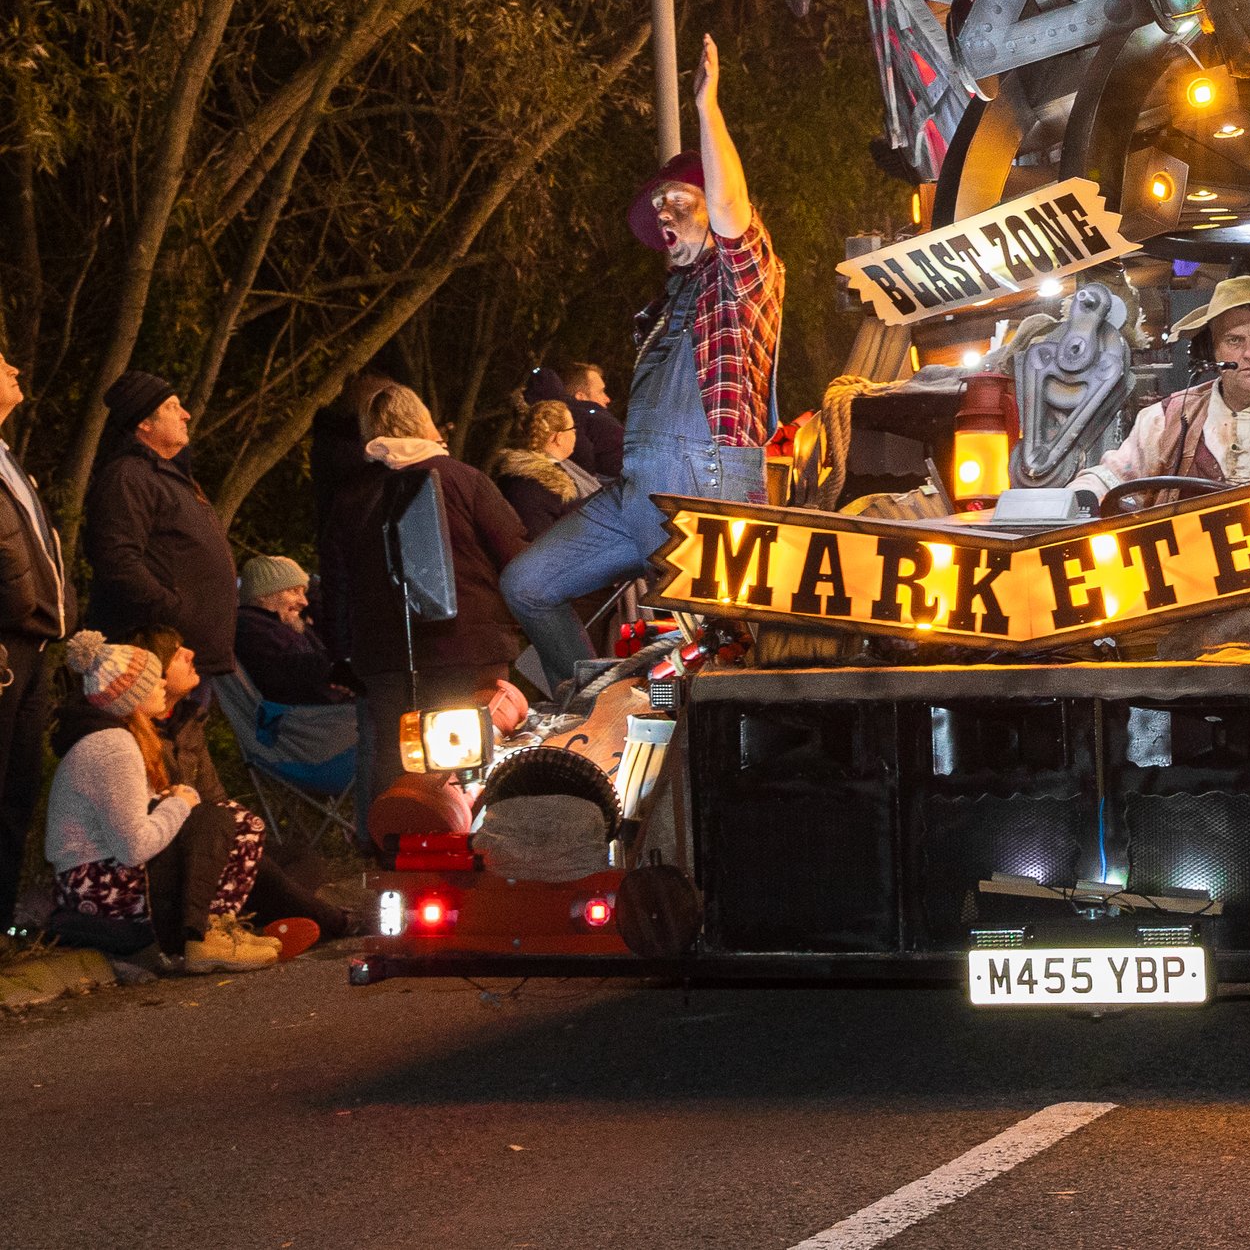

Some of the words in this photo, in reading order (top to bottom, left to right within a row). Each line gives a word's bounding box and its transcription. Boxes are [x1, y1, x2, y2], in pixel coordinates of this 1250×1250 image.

[861, 234, 1001, 316] BLAST
[979, 193, 1111, 282] ZONE
[988, 957, 1093, 995] M455
[1107, 956, 1186, 994] YBP
